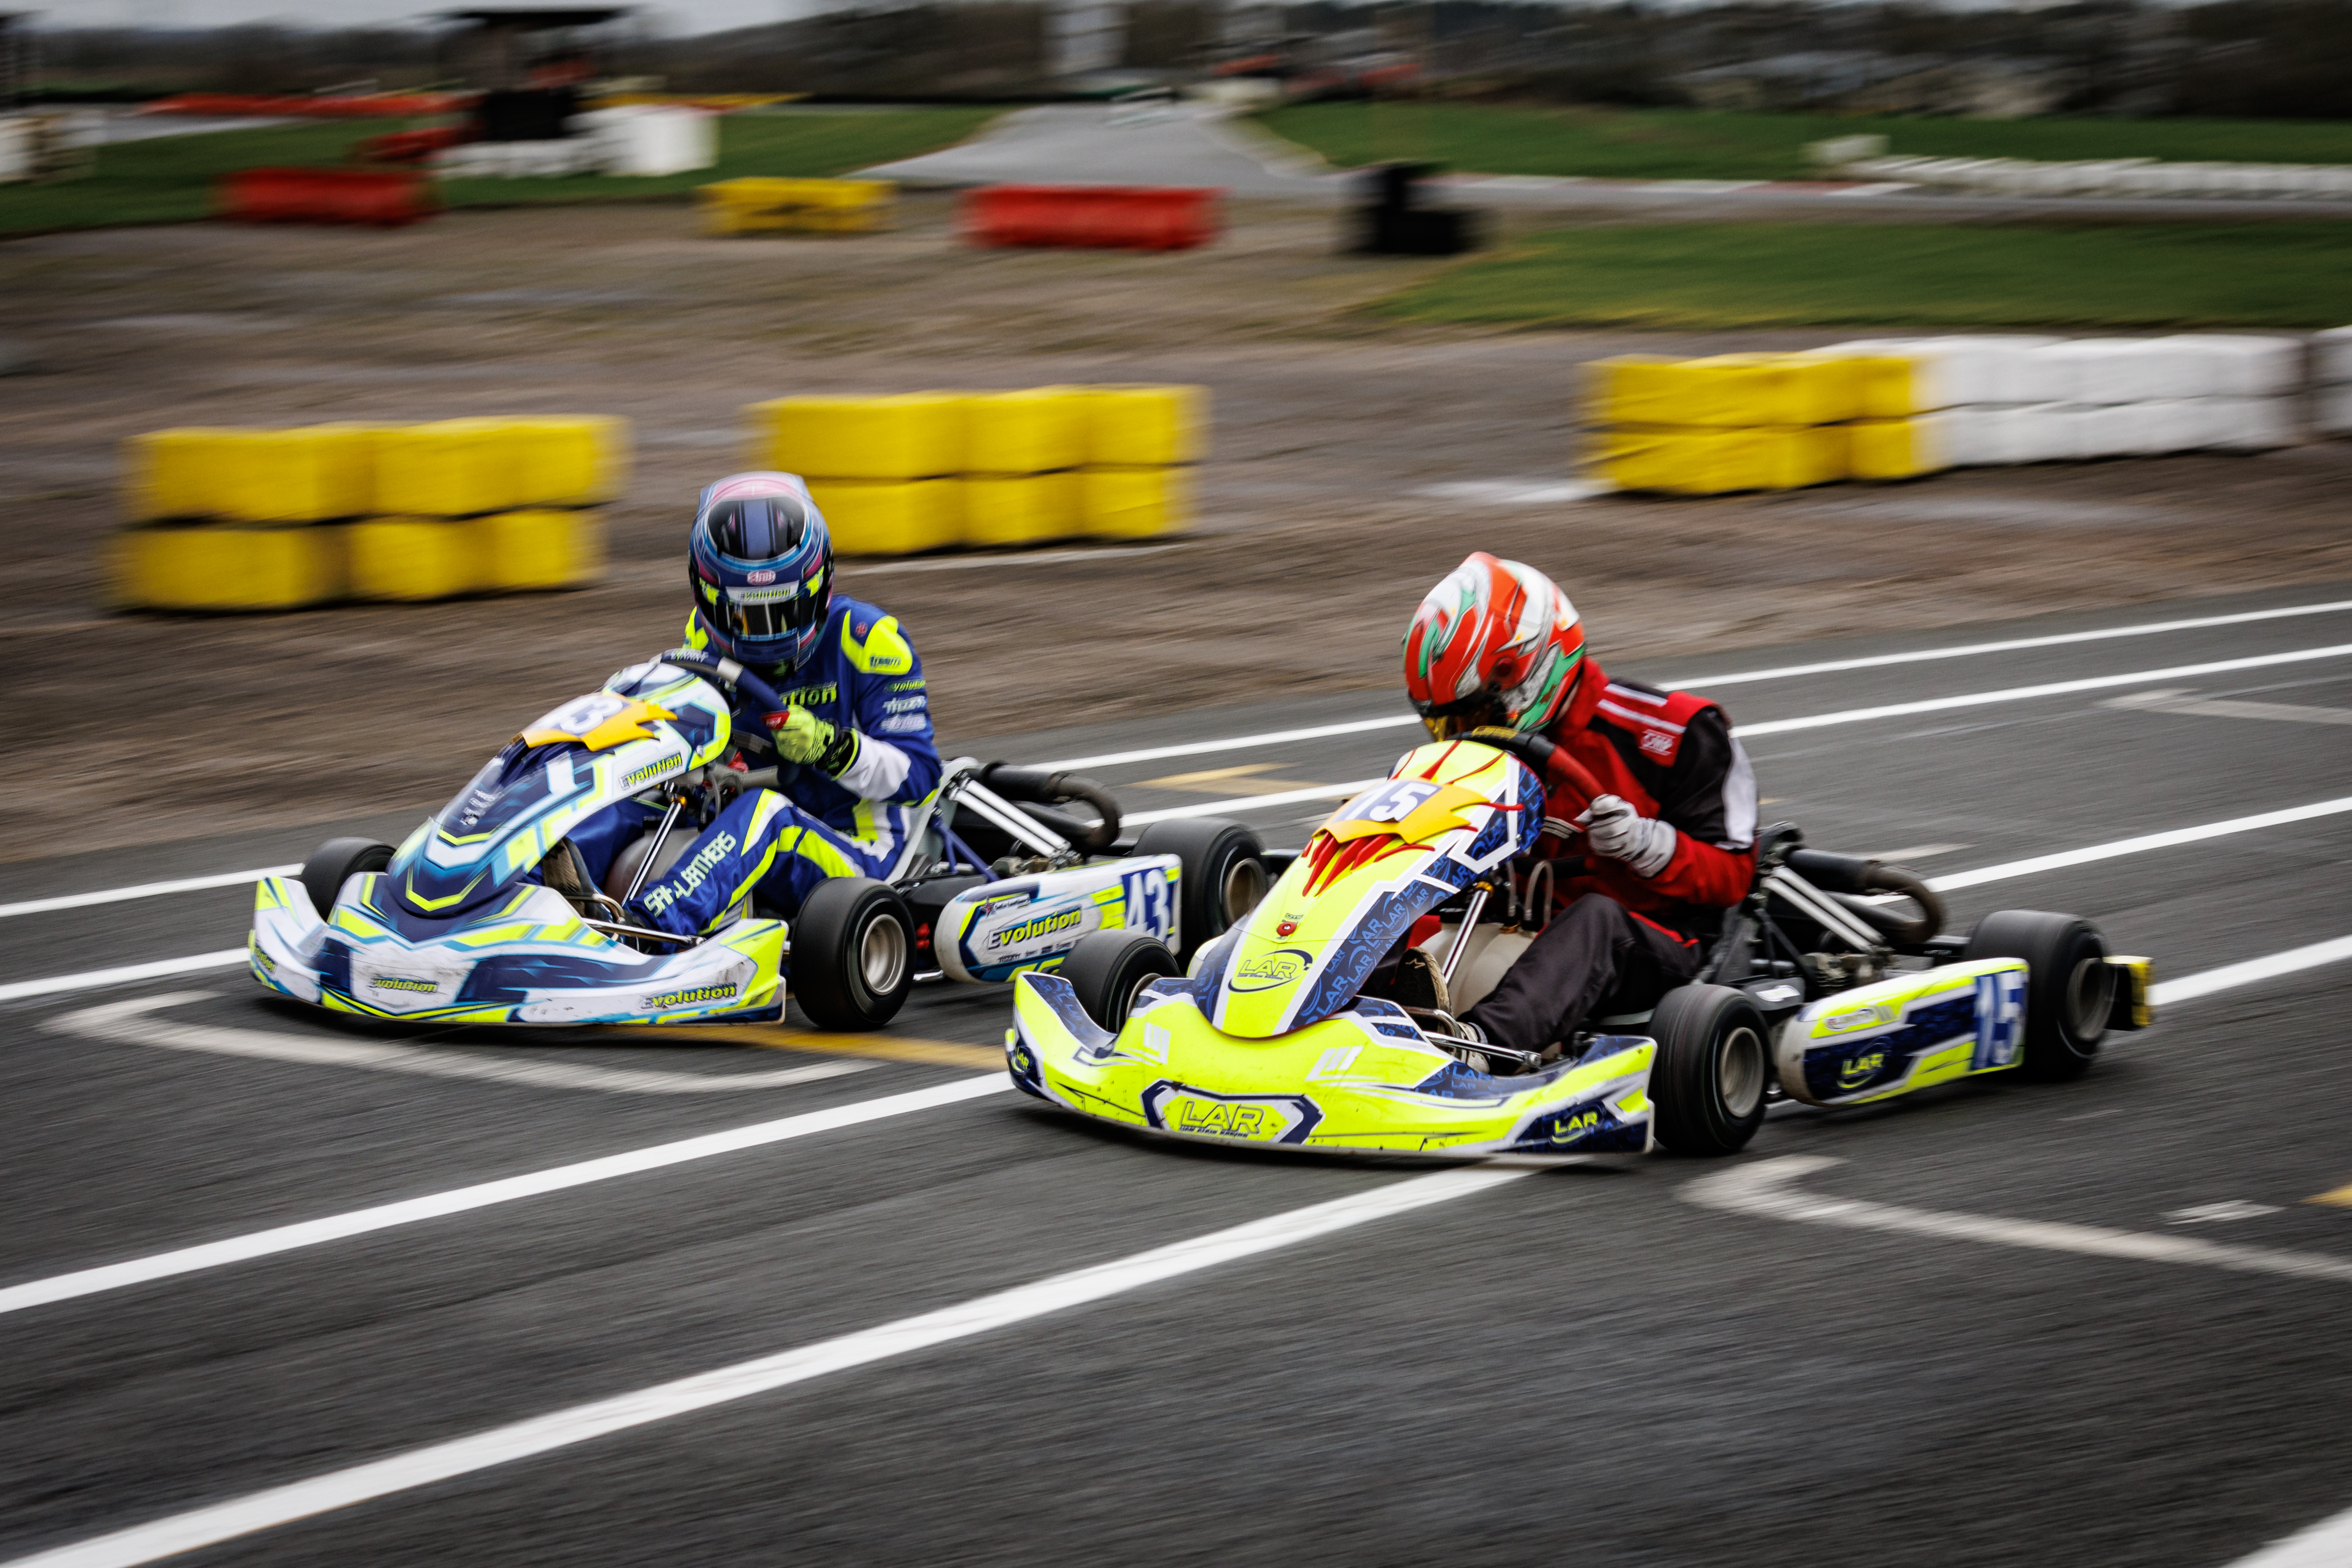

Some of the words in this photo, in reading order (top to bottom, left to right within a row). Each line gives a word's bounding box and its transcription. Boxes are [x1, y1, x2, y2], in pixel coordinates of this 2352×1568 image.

[1345, 782, 1438, 822] 15
[1126, 869, 1170, 943] 43
[1411, 888, 1429, 909] LAR
[987, 909, 1081, 950] Evolution
[1382, 903, 1406, 929] LAR
[1362, 918, 1383, 948] LAR
[1239, 960, 1297, 978] LAR
[1325, 949, 1346, 974] LAR
[1347, 955, 1373, 984] LAR
[641, 985, 736, 1009] Evolution
[1317, 976, 1348, 1015] LAR
[1972, 972, 2027, 1068] 15
[1841, 1052, 1884, 1075] LAR
[1180, 1101, 1265, 1134] LAR
[1555, 1111, 1599, 1133] LAR
